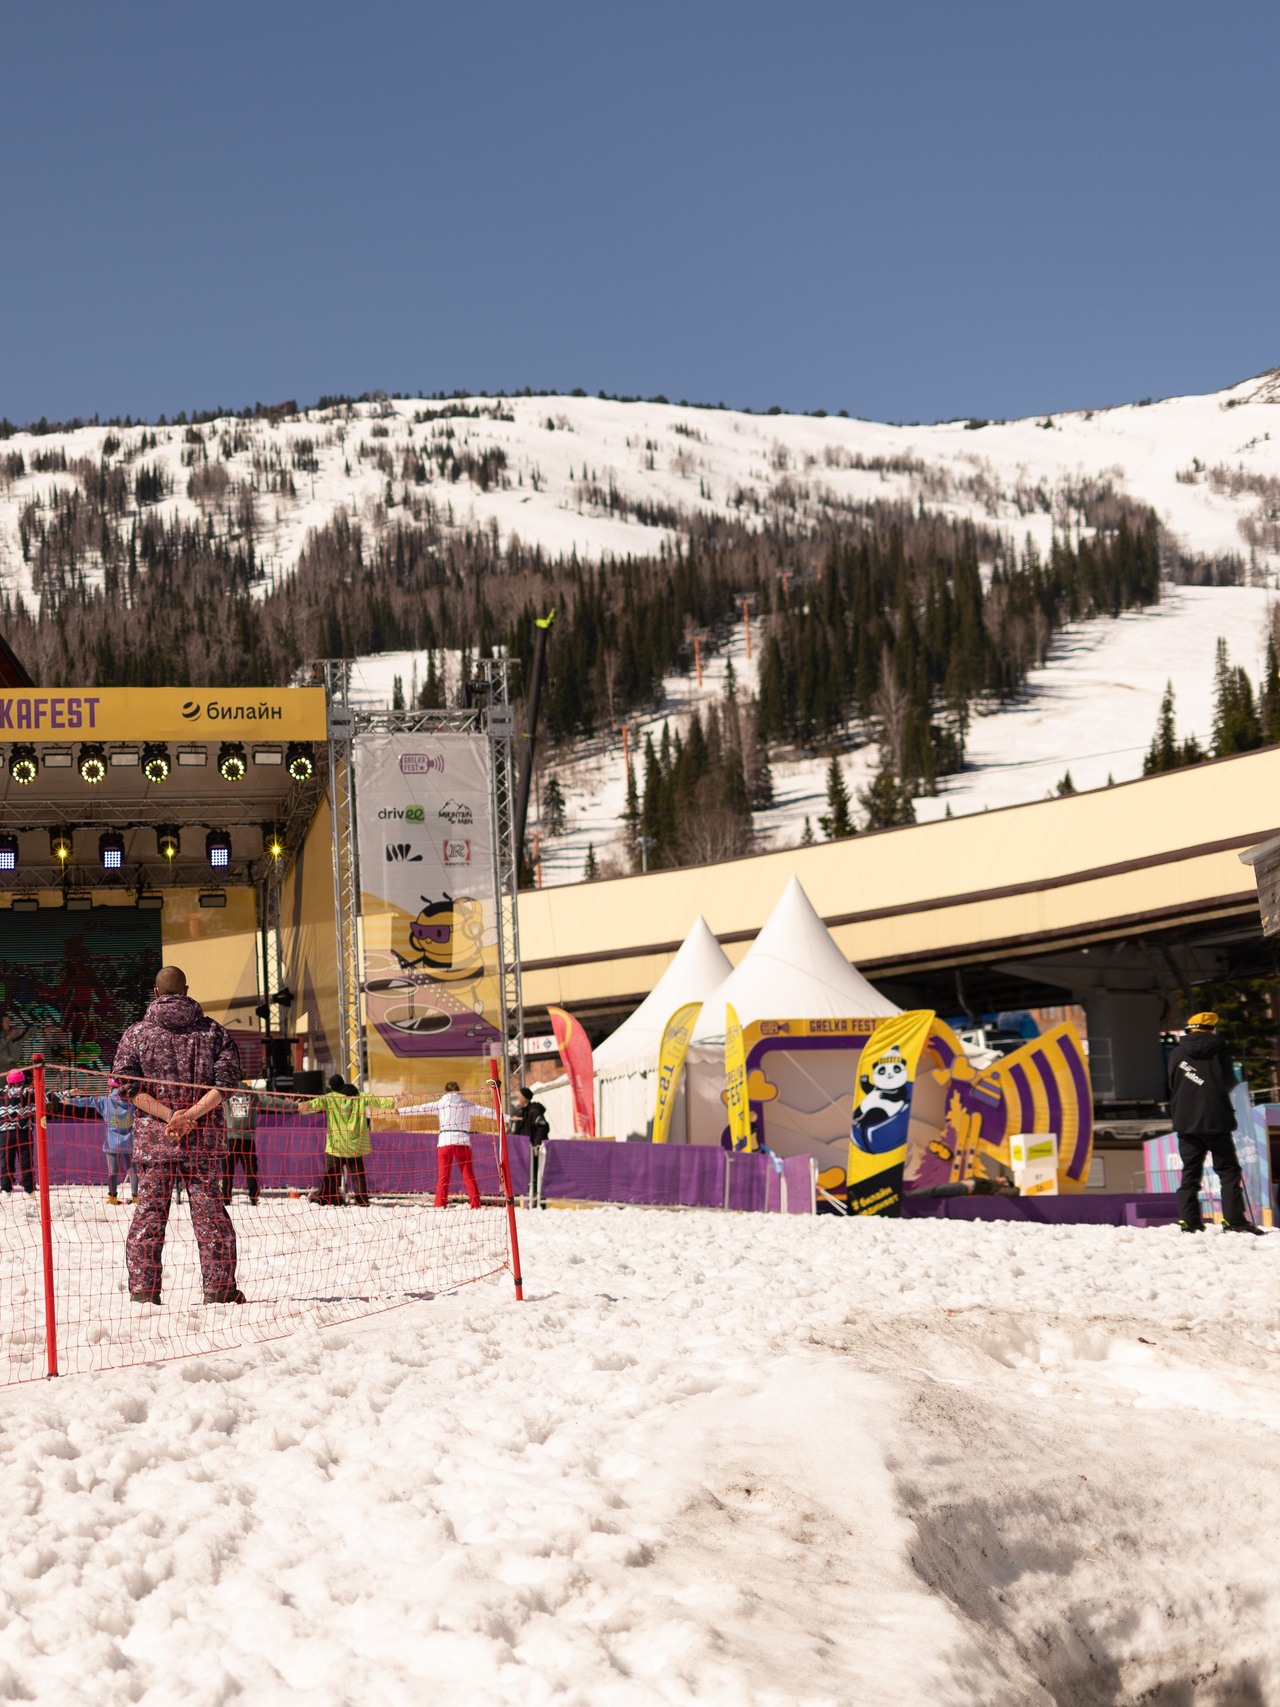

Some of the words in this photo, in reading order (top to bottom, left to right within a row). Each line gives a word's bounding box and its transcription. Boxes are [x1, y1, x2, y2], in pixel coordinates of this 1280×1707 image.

[206, 702, 282, 720] билайн
[378, 808, 425, 821] drivee
[809, 1020, 848, 1033] GRELKA
[852, 1019, 876, 1032] FEST
